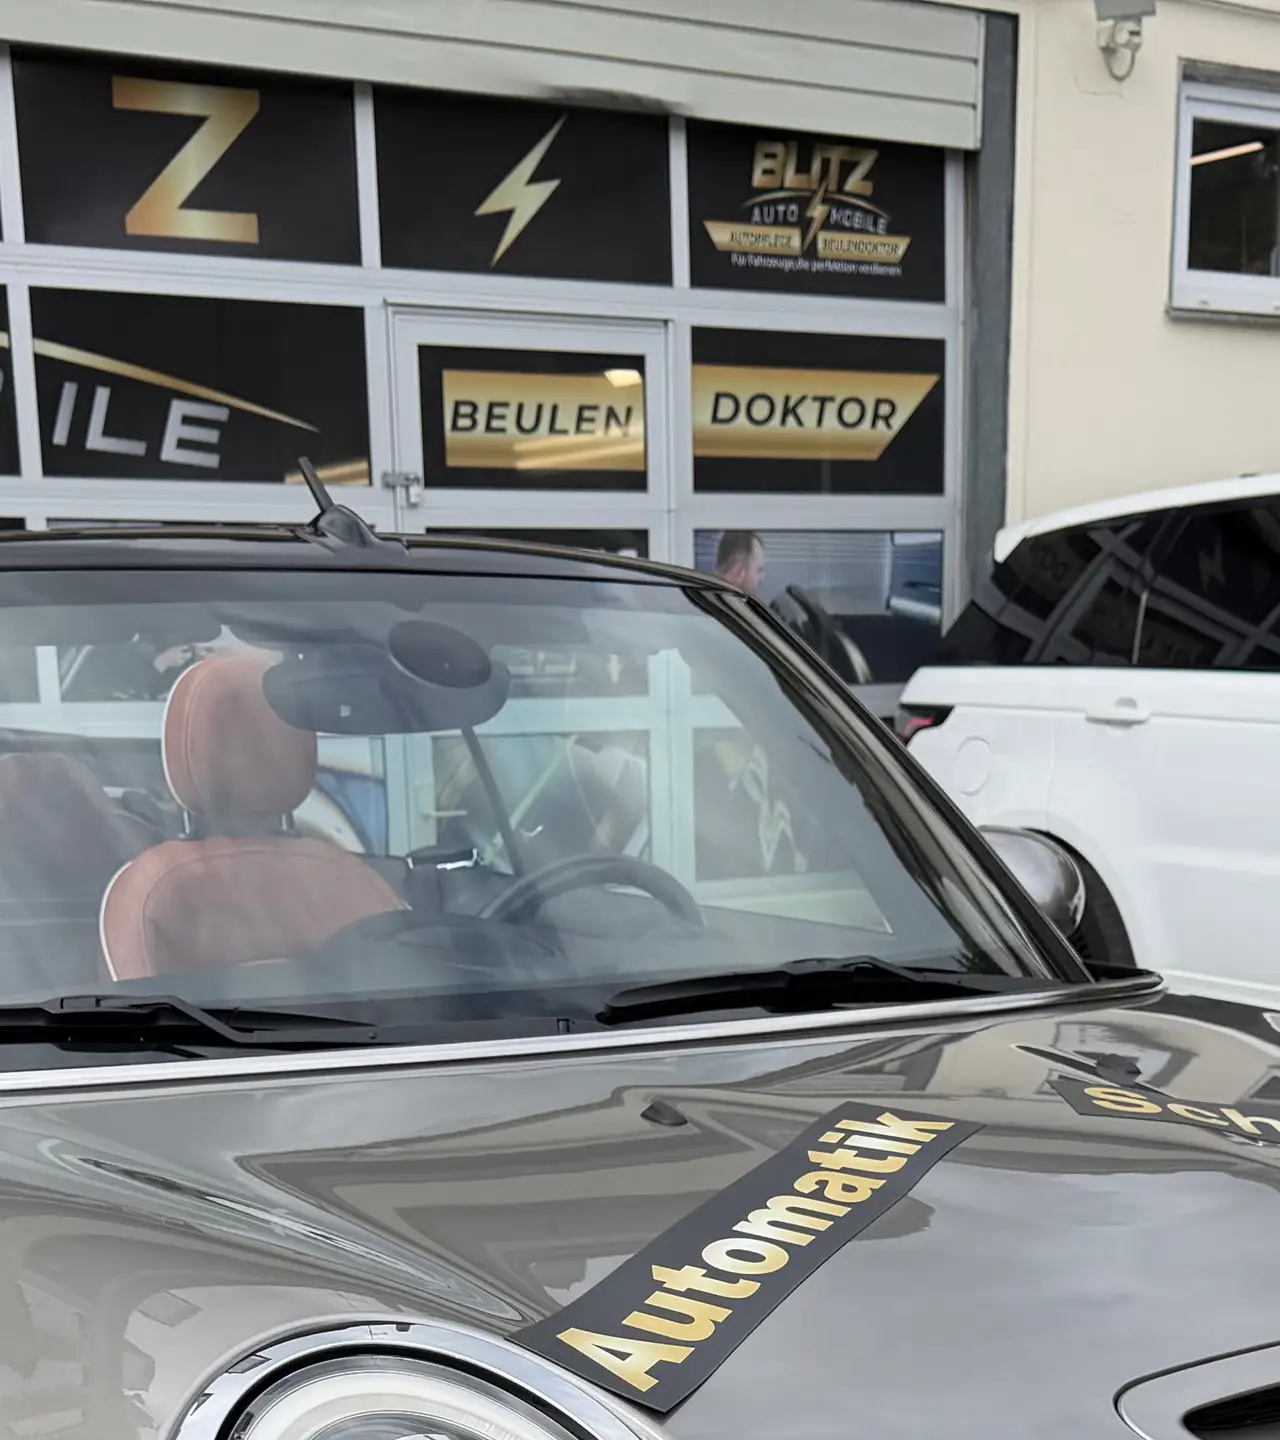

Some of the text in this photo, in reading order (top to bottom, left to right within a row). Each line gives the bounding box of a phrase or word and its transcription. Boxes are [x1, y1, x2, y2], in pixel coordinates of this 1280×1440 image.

[751, 140, 879, 196] BLITZ
[751, 203, 889, 235] AUTO MOBILE
[450, 391, 898, 438] BEULEN DOKTOR
[556, 1112, 955, 1392] Automatik
